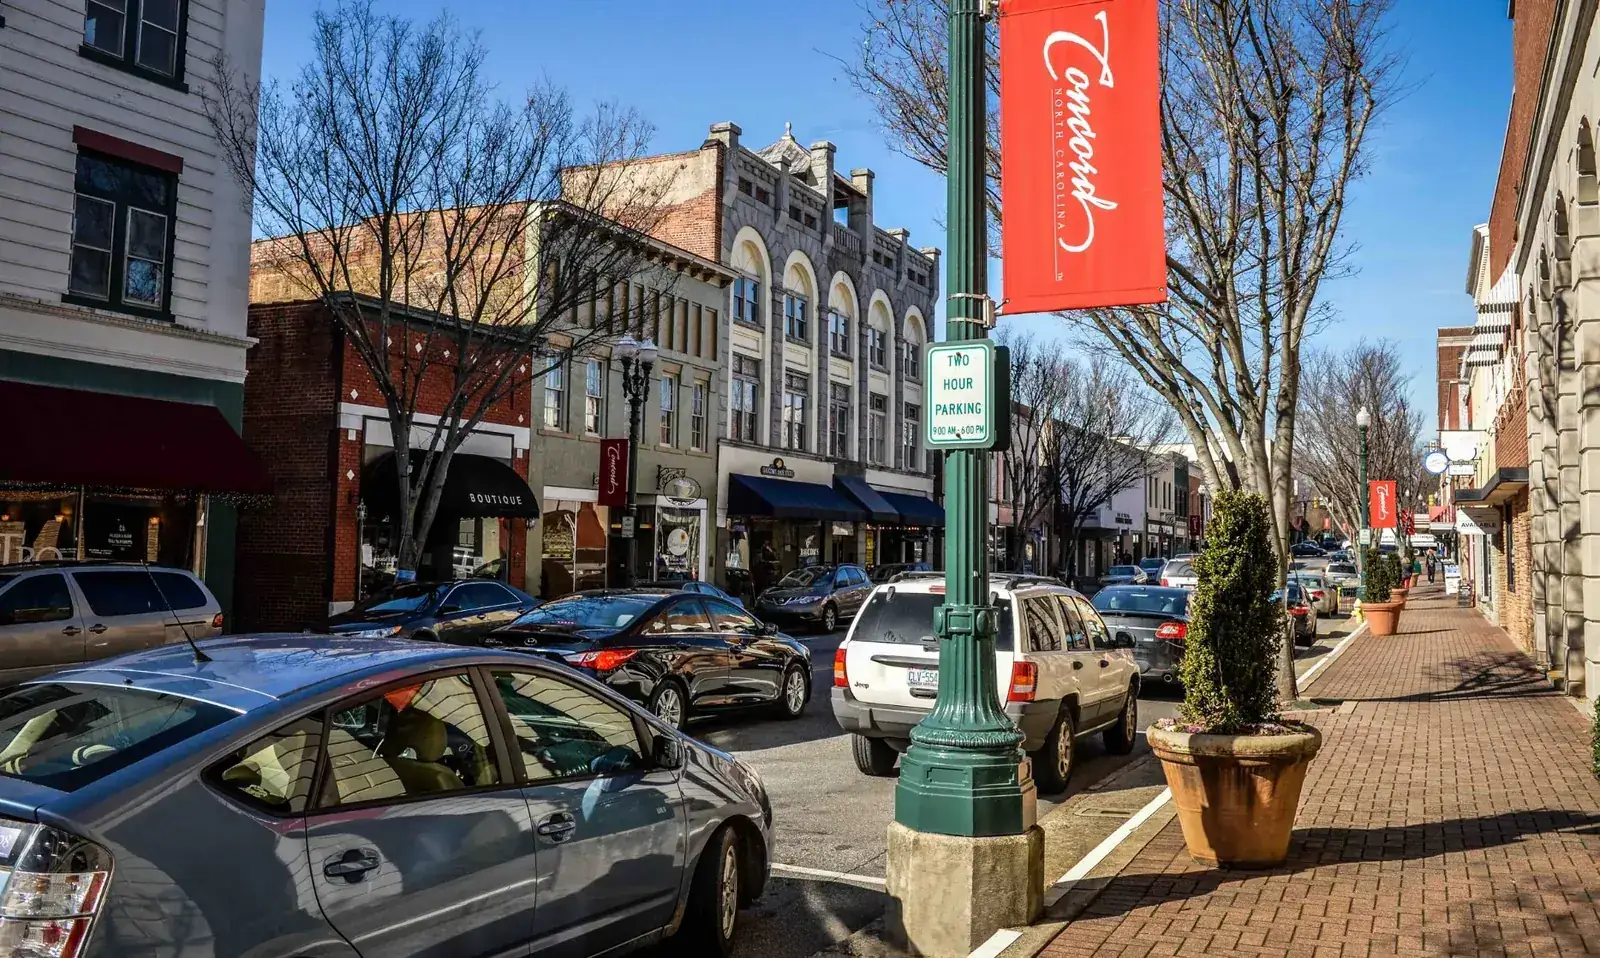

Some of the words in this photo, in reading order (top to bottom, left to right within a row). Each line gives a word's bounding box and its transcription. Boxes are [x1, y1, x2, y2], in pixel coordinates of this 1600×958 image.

[1054, 87, 1063, 139] NORTH
[1042, 9, 1119, 253] Concord
[1055, 149, 1066, 231] CAROLINA
[948, 354, 969, 367] TWO
[943, 378, 973, 390] HOUR
[935, 402, 982, 415] PARKING
[947, 425, 956, 434] AM
[975, 424, 985, 434] PM
[607, 442, 620, 495] Concord
[469, 493, 523, 505] BOUTIQUE
[854, 680, 870, 690] Jeep
